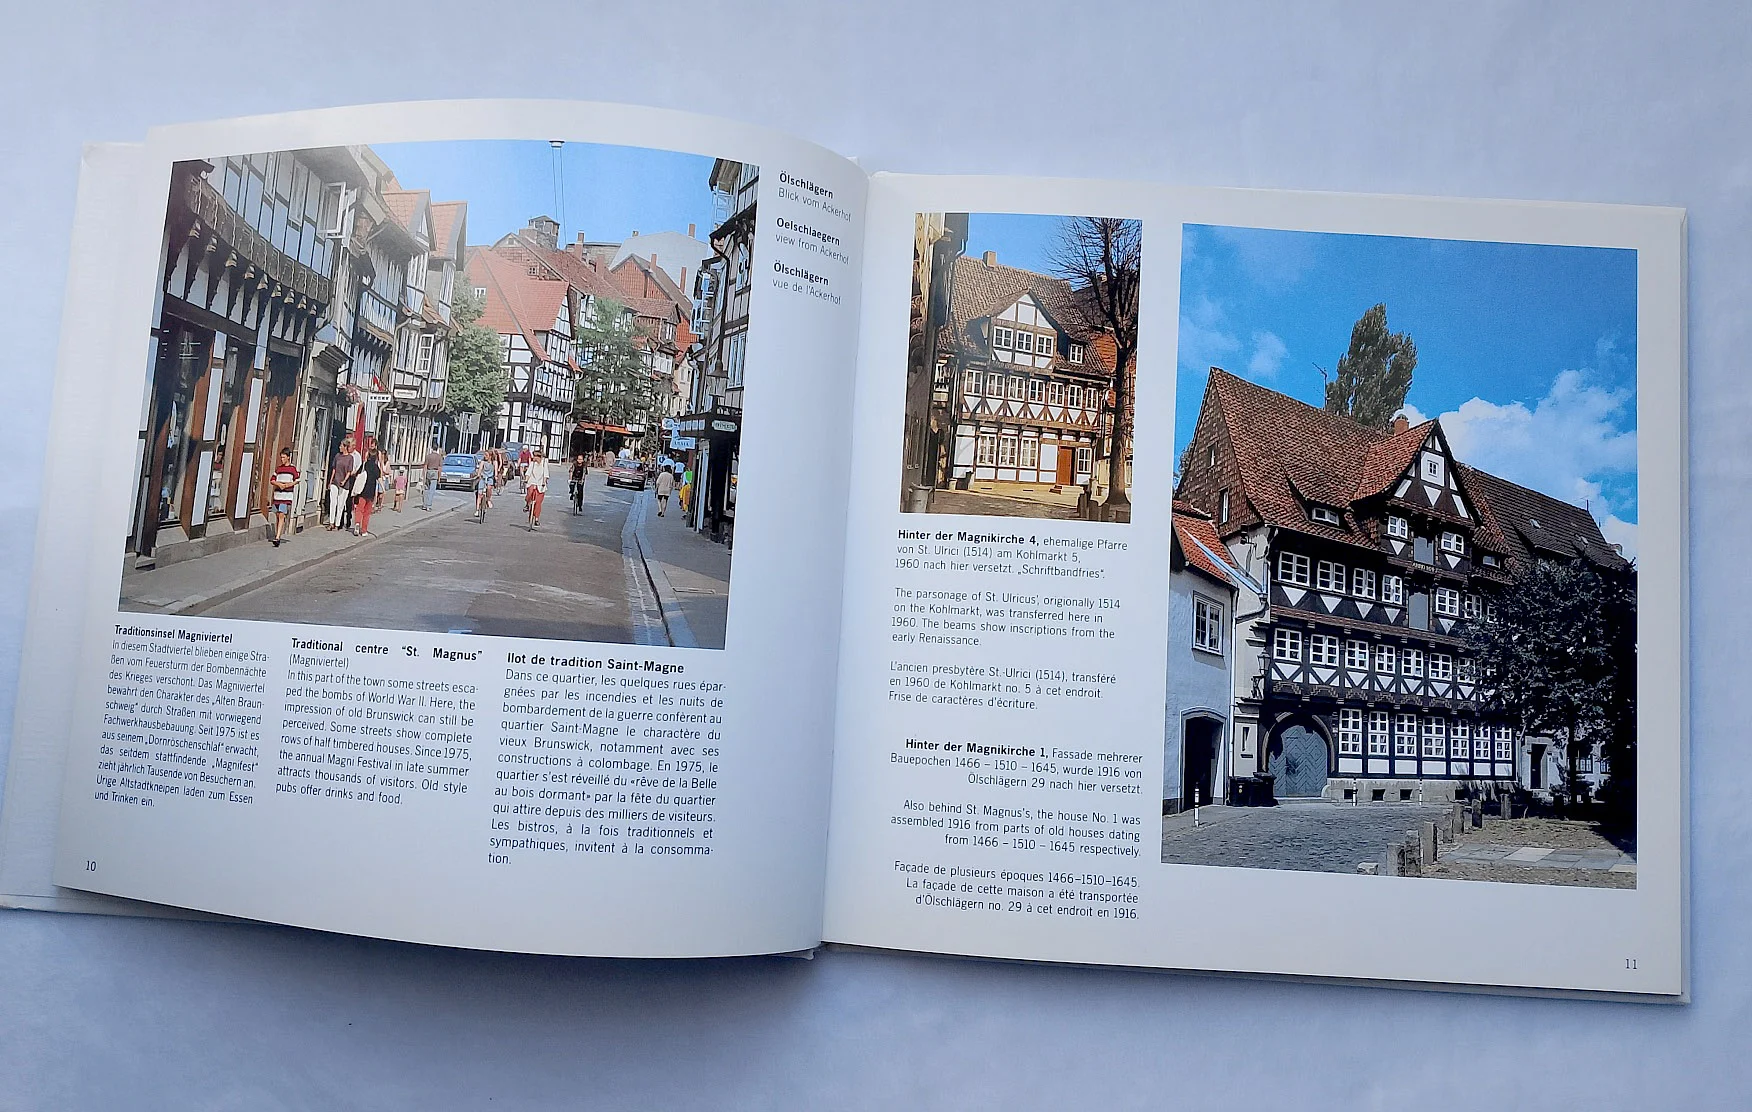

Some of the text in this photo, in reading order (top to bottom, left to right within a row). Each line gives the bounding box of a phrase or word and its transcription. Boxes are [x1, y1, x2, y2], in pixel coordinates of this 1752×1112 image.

[779, 170, 833, 199] Ölschlägern
[778, 187, 851, 222] Blick vom Ackerhof
[776, 217, 840, 246] Oelschlaegern
[775, 234, 849, 265] view from Ackerhof
[774, 259, 829, 286] Ölschlägern
[773, 279, 789, 290] vue
[792, 282, 803, 293] de
[898, 529, 1128, 551] Hinter der Magnikirche 4, ehemalige Pfarre
[897, 544, 1081, 564] von St. Ulrici (1514) am Kohlmarkt 5,
[895, 558, 919, 569] 1960
[923, 560, 946, 570] nach
[950, 560, 969, 571] hier
[973, 563, 1014, 573] versetzt.
[894, 603, 1103, 623] on the Kohlmarkt, was transferred here in
[115, 624, 233, 643] Traditionsinsel Magniviertel
[892, 632, 982, 646] early Renaissance.
[291, 637, 343, 652] Traditional
[355, 644, 389, 655] centre
[289, 653, 349, 670] (Magniviertel)
[531, 654, 546, 665] de
[550, 656, 602, 669] tradition
[607, 658, 684, 675] Saint-Magne
[109, 669, 265, 693] des Krieges verschont. Das Magniviertel
[932, 665, 985, 677] presbytère
[1072, 672, 1116, 684] transféré
[889, 690, 911, 702] Frise
[915, 692, 928, 703] de
[141, 703, 163, 714] durch
[166, 705, 196, 718] Straßen
[199, 710, 212, 720] mit
[215, 712, 262, 726] vorwiegend
[284, 704, 474, 727] impression of old Brunswick can still be
[502, 701, 722, 724] bombardement de la guerre confèrent au
[501, 720, 721, 740] quartier Saint-Magne le charactère du
[499, 735, 719, 757] vieux Brunswick, notamment avec ses
[906, 738, 1143, 763] Hinter der Magnikirche 1, Fassade mehrerer
[96, 774, 253, 804] Urige Altstadtkneipen laden zum Essen
[277, 765, 468, 795] attracts thousands of visitors. Old style
[968, 771, 1143, 794] Ölschlägern 29 nach hier versetzt.
[95, 791, 155, 807] und Trinken ein.
[276, 782, 403, 805] pubs offer drinks and food.
[891, 816, 1140, 843] assembled 1916 from parts of old houses dating
[490, 837, 713, 855] sympathiques, invitent à la consomma-
[86, 860, 96, 872] 10
[488, 852, 511, 864] tion.
[894, 860, 929, 874] Façade
[933, 864, 946, 875] de
[950, 866, 996, 879] plusieurs
[1000, 869, 1044, 883] époques
[906, 877, 1138, 904] La façade de cette maison a été transportée
[1626, 958, 1637, 970] 11
